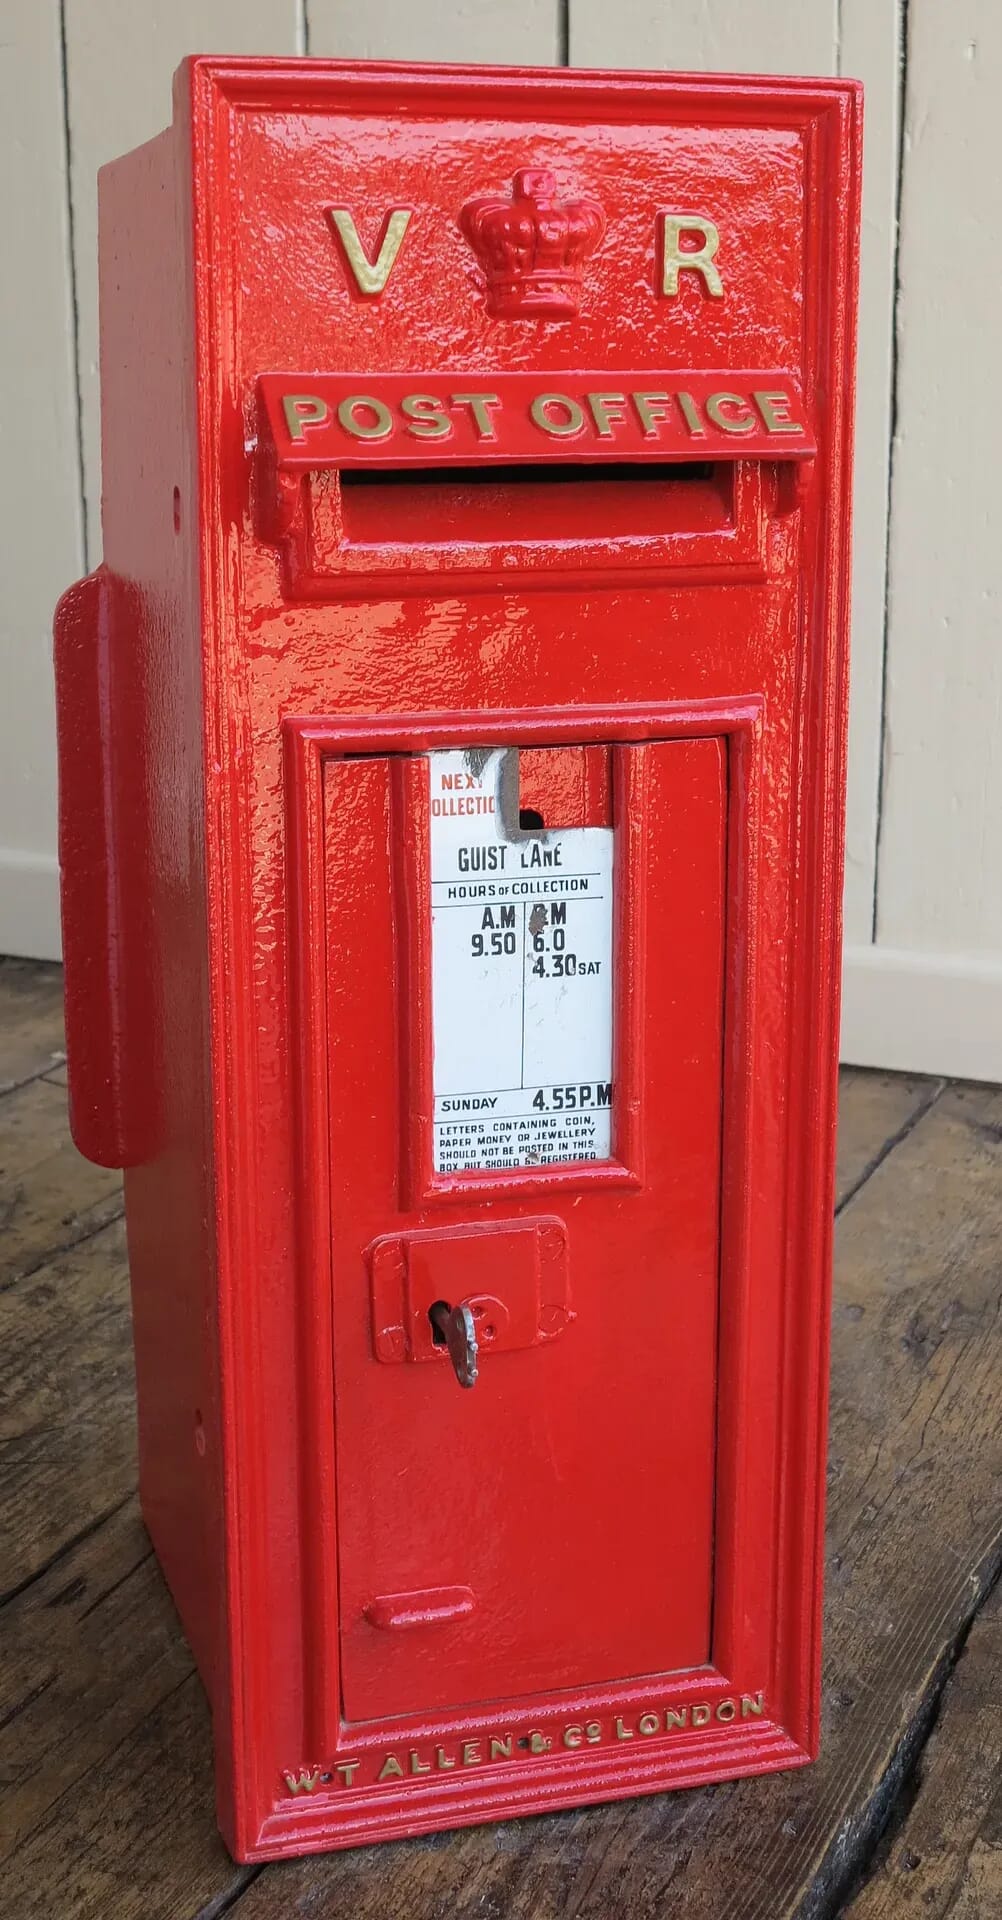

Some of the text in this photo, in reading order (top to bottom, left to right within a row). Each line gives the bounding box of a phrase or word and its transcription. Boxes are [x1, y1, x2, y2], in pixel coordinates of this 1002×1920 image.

[330, 208, 724, 297] V R
[282, 390, 804, 444] POST OFFICE
[458, 842, 562, 872] GUIST LANE
[448, 885, 496, 899] HOURS
[512, 879, 588, 895] COLLECTION
[481, 905, 516, 929] A.M
[471, 932, 516, 957] 9.50
[533, 928, 565, 952] 6.0
[441, 1097, 498, 1112] SUNDAY
[440, 1124, 485, 1136] LETTERS
[493, 1118, 557, 1132] CONTAINING
[440, 1128, 596, 1147] PAPER MONEY OR JEWELLERY
[440, 1140, 594, 1160] SHOULD NOT BE POSTED IN THIS
[440, 1163, 458, 1172] BOX
[485, 1158, 520, 1169] SHOULD
[541, 1152, 596, 1164] REGISTERED
[378, 1732, 512, 1780] ALLEN
[615, 1694, 764, 1740] LONDON
